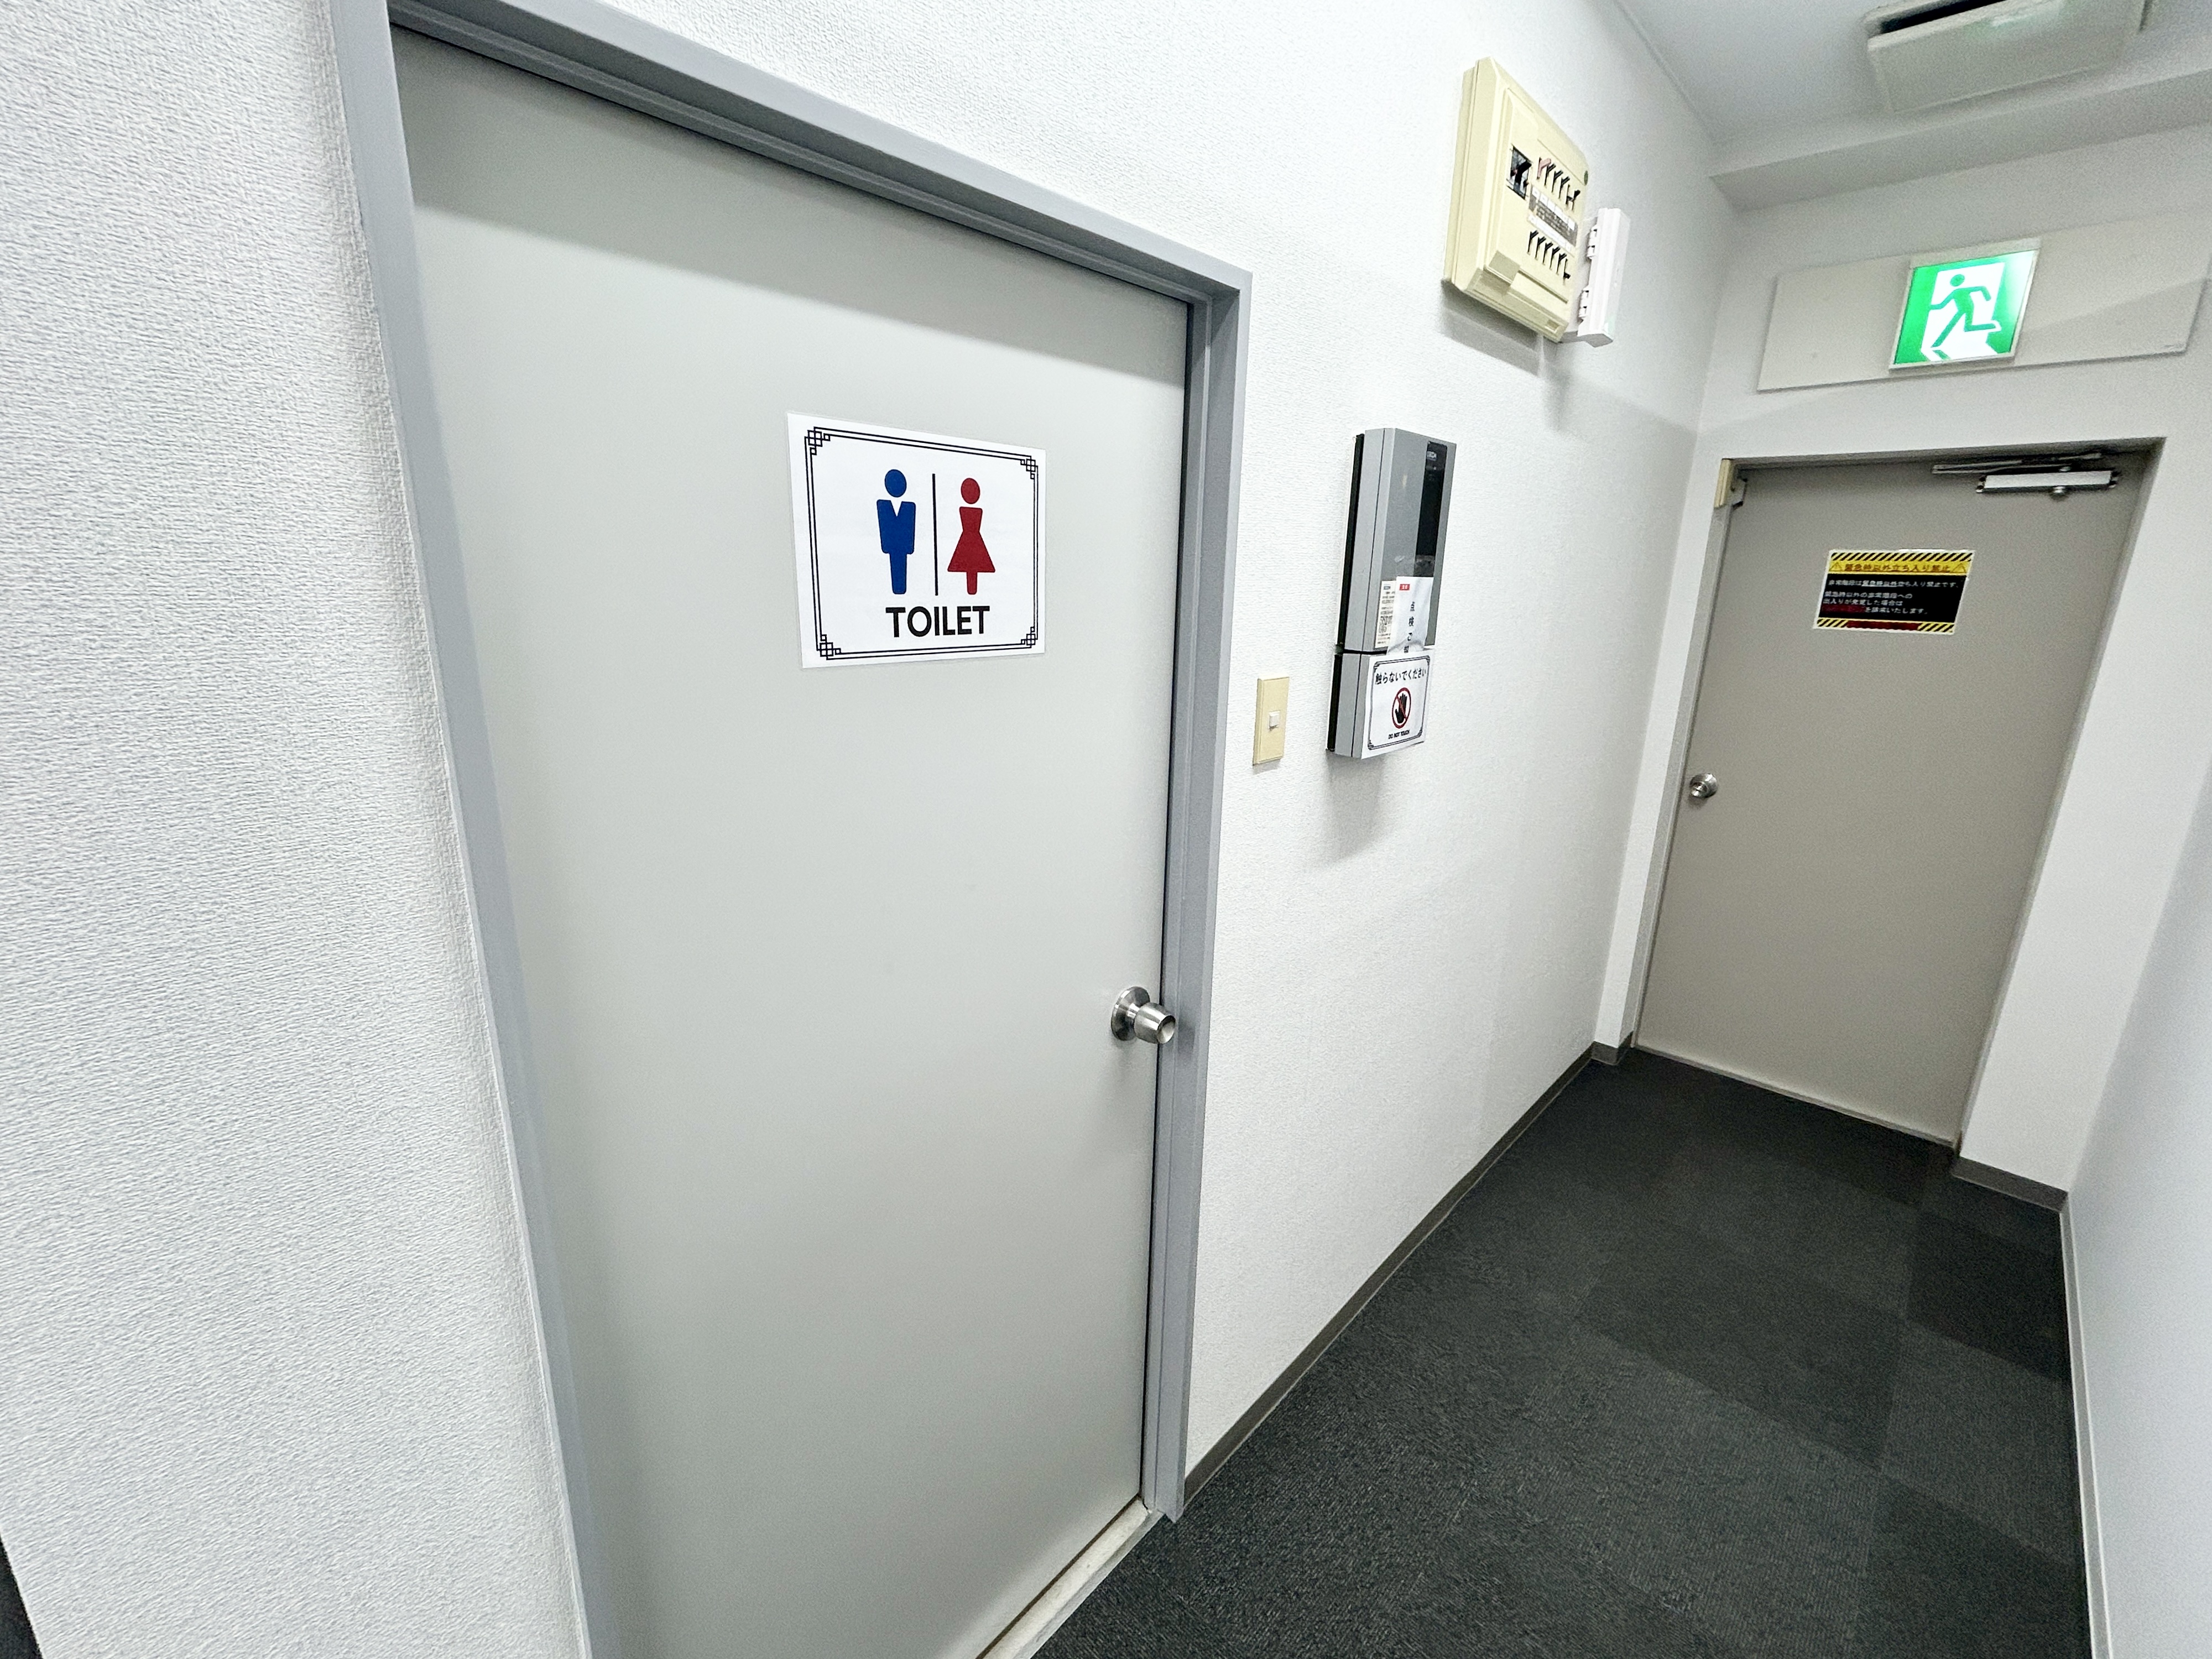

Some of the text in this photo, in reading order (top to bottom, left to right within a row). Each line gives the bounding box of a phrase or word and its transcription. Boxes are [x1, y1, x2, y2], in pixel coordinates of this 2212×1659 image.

[886, 606, 990, 637] TOILET
[1375, 668, 1426, 685] 触らないでください
